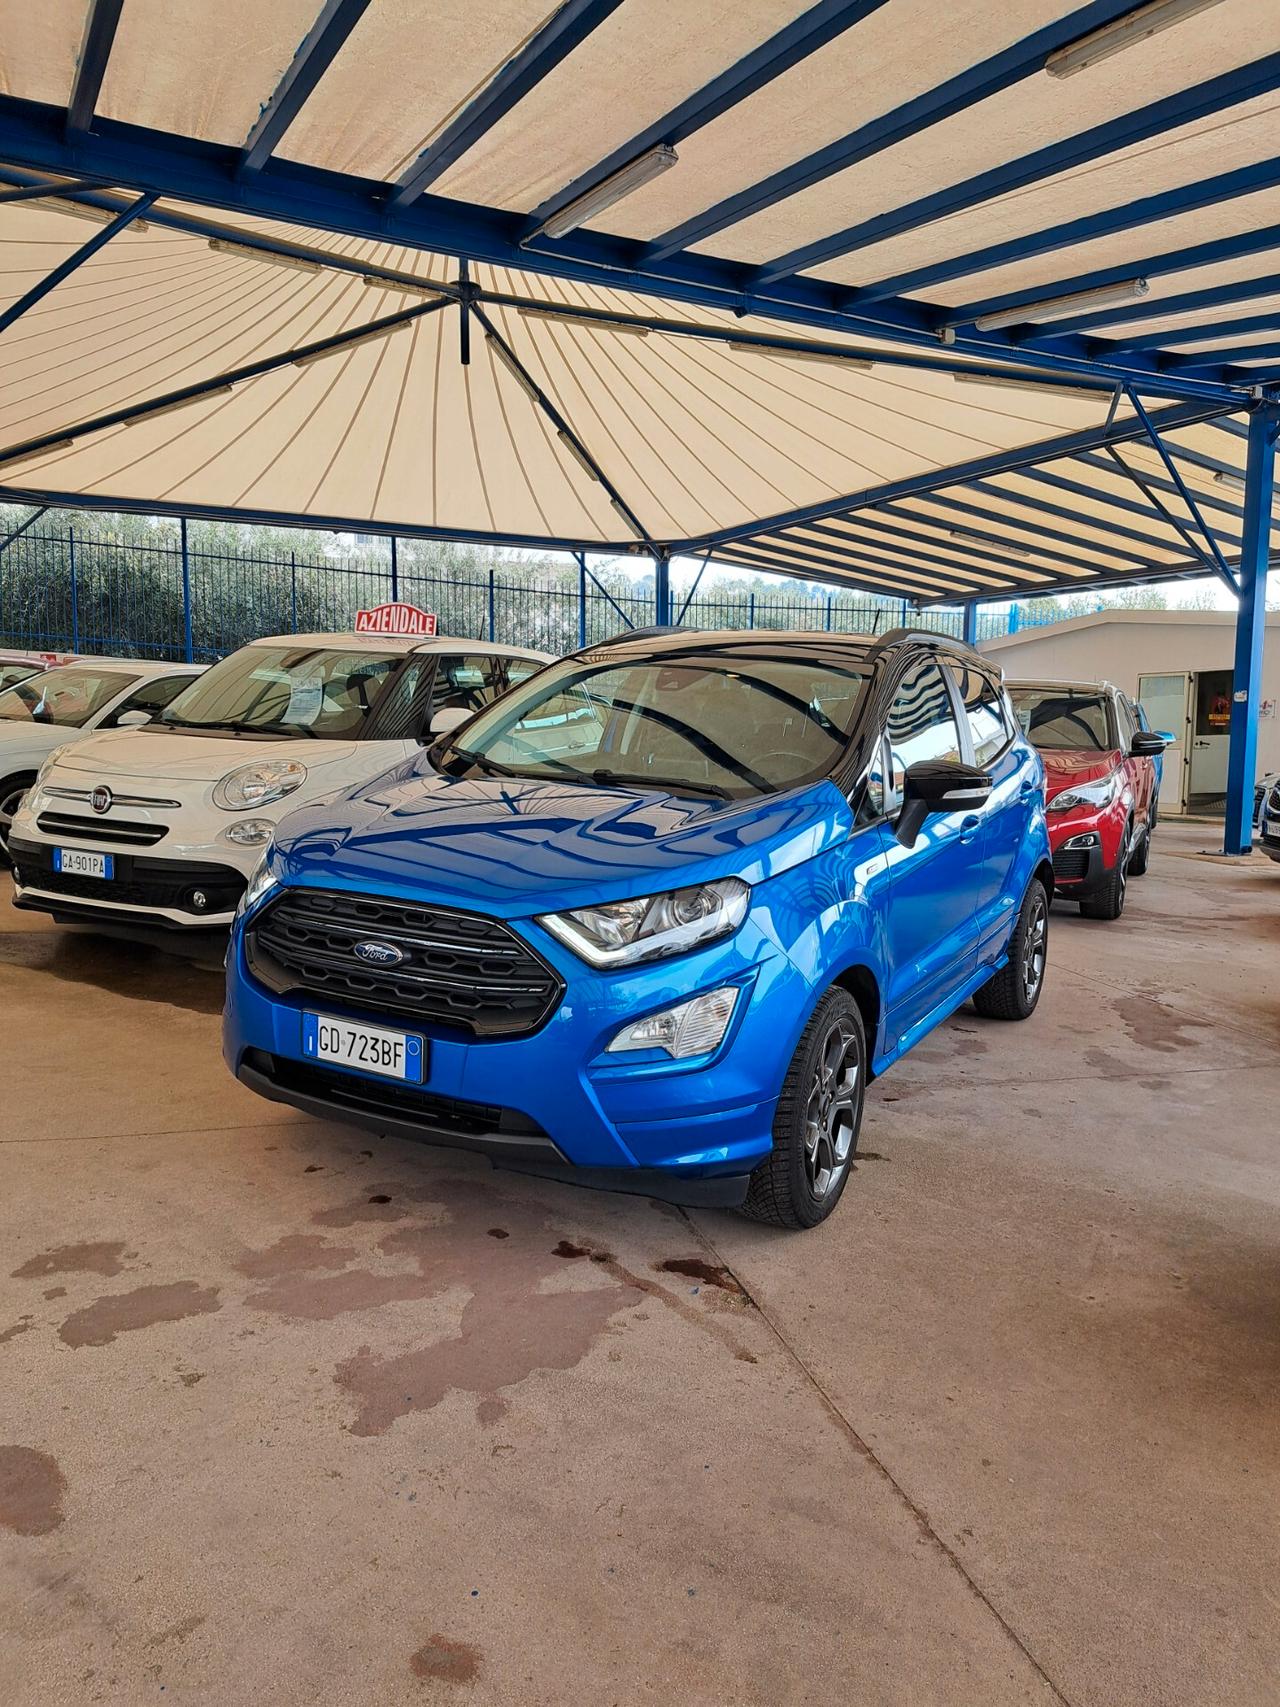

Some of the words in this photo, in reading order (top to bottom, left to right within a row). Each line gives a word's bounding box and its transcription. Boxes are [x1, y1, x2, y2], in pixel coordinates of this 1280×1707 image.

[358, 606, 433, 634] AZIENDALE
[361, 943, 392, 960] Ford
[347, 1031, 404, 1069] 723BF
